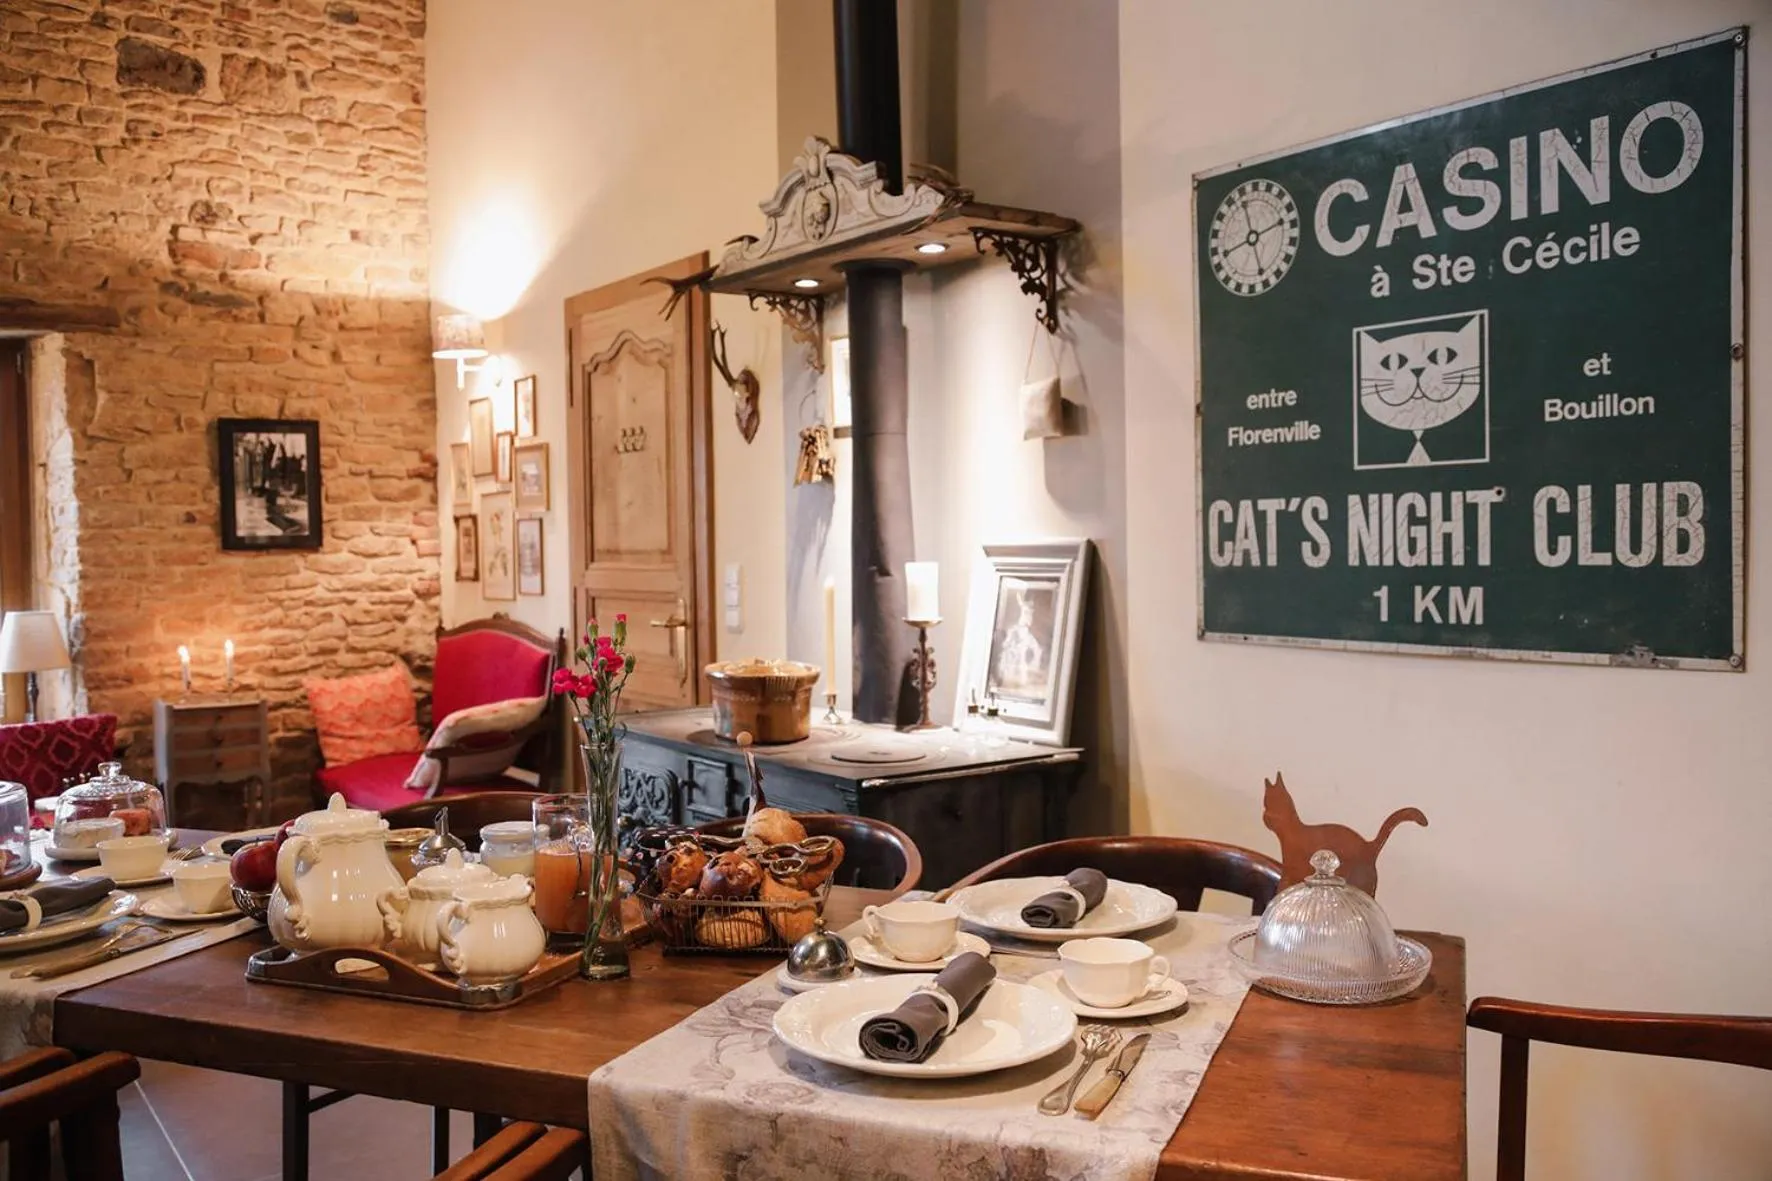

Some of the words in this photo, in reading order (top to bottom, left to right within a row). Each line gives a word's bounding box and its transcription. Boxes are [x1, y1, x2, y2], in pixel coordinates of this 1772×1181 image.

[1314, 100, 1704, 257] CASINO
[1370, 264, 1390, 298] à
[1412, 253, 1476, 290] Ste
[1502, 222, 1641, 275] Cécile
[1583, 352, 1612, 377] et
[1246, 387, 1297, 410] entre
[1544, 393, 1655, 422] Bouillon
[1227, 419, 1322, 447] Florenville
[1207, 495, 1332, 568] CAT'S
[1347, 486, 1506, 568] NIGHT
[1533, 481, 1705, 568] CLUB
[1372, 585, 1389, 623] 1
[1413, 585, 1484, 626] KM
